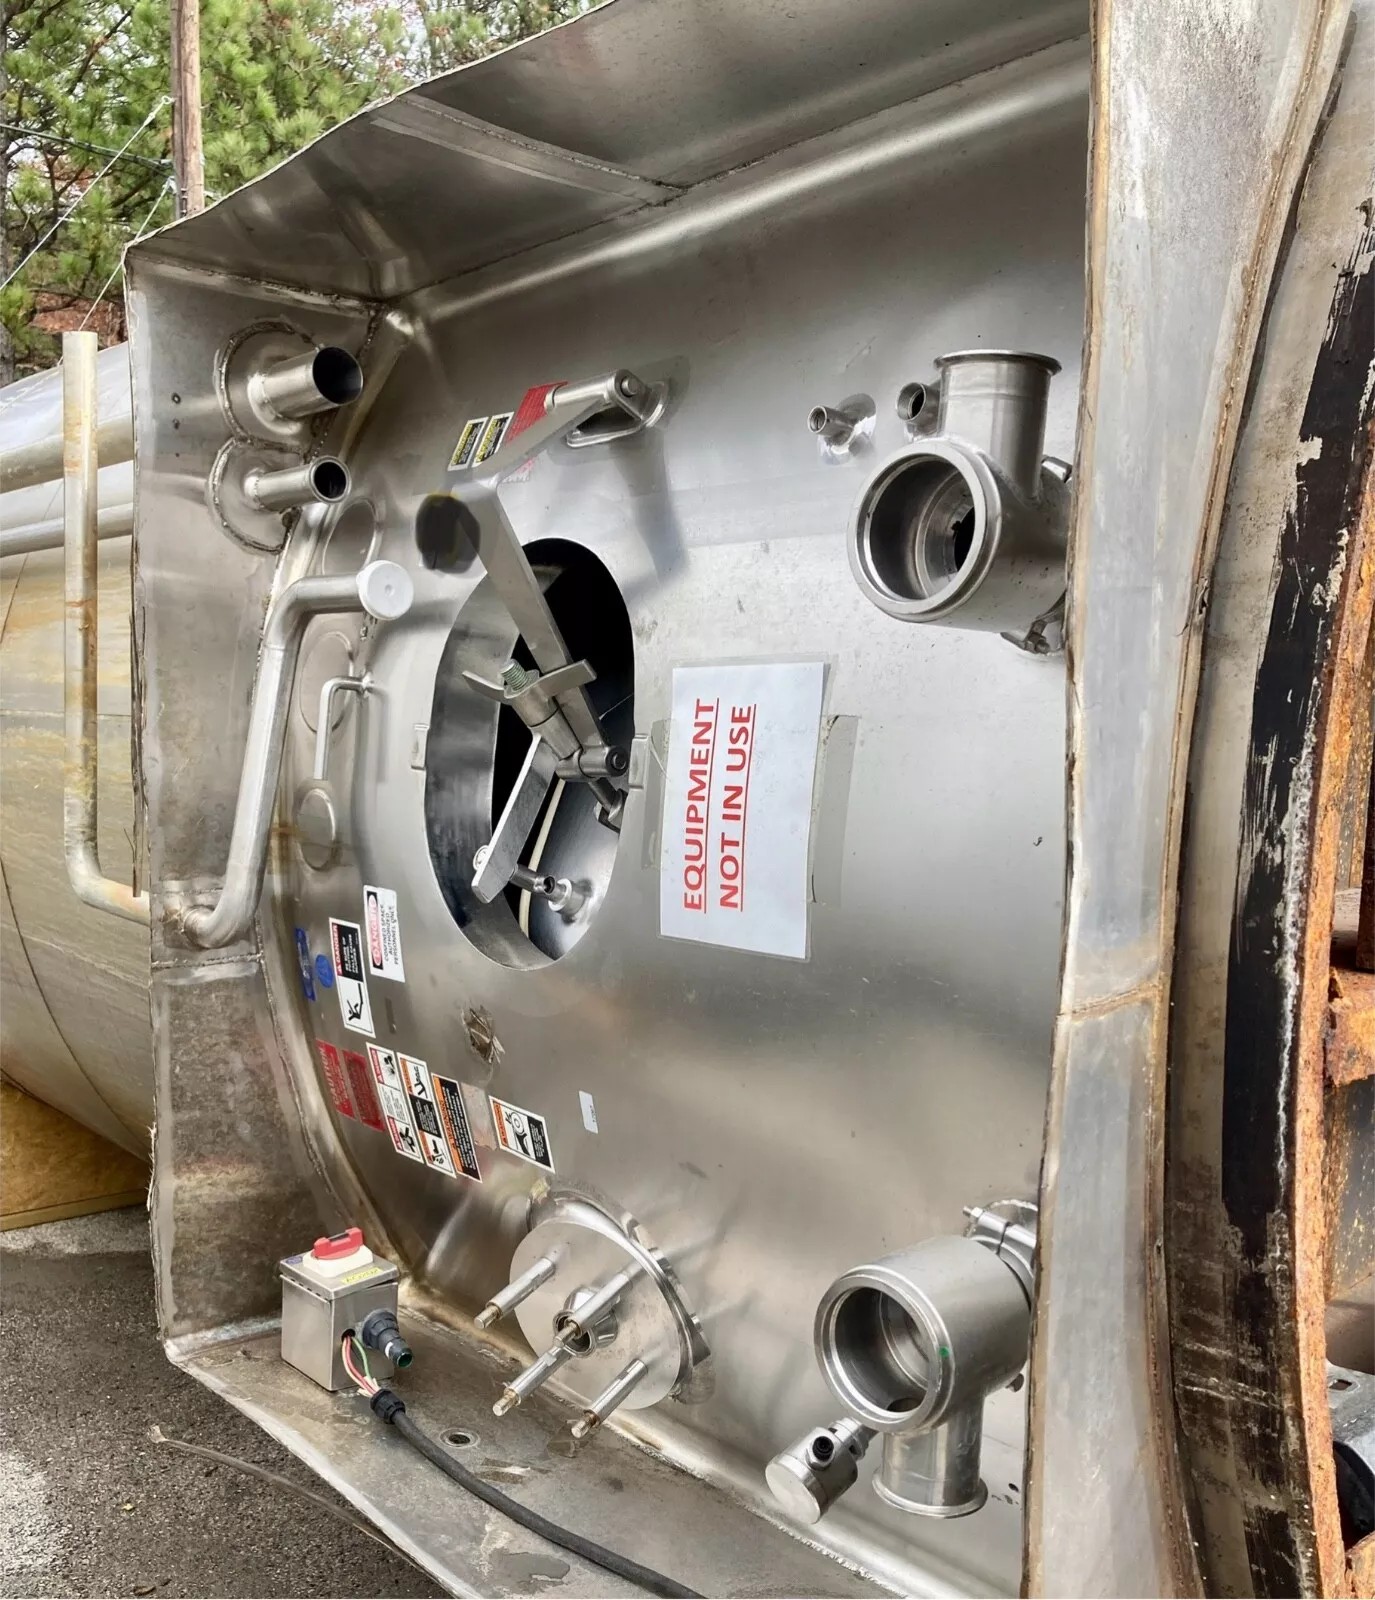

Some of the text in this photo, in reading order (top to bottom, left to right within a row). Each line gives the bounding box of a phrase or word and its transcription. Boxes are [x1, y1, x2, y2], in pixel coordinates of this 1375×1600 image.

[684, 698, 715, 910] EQUIPMENT
[719, 706, 751, 909] NOT IN USE
[333, 924, 341, 961] DANGER
